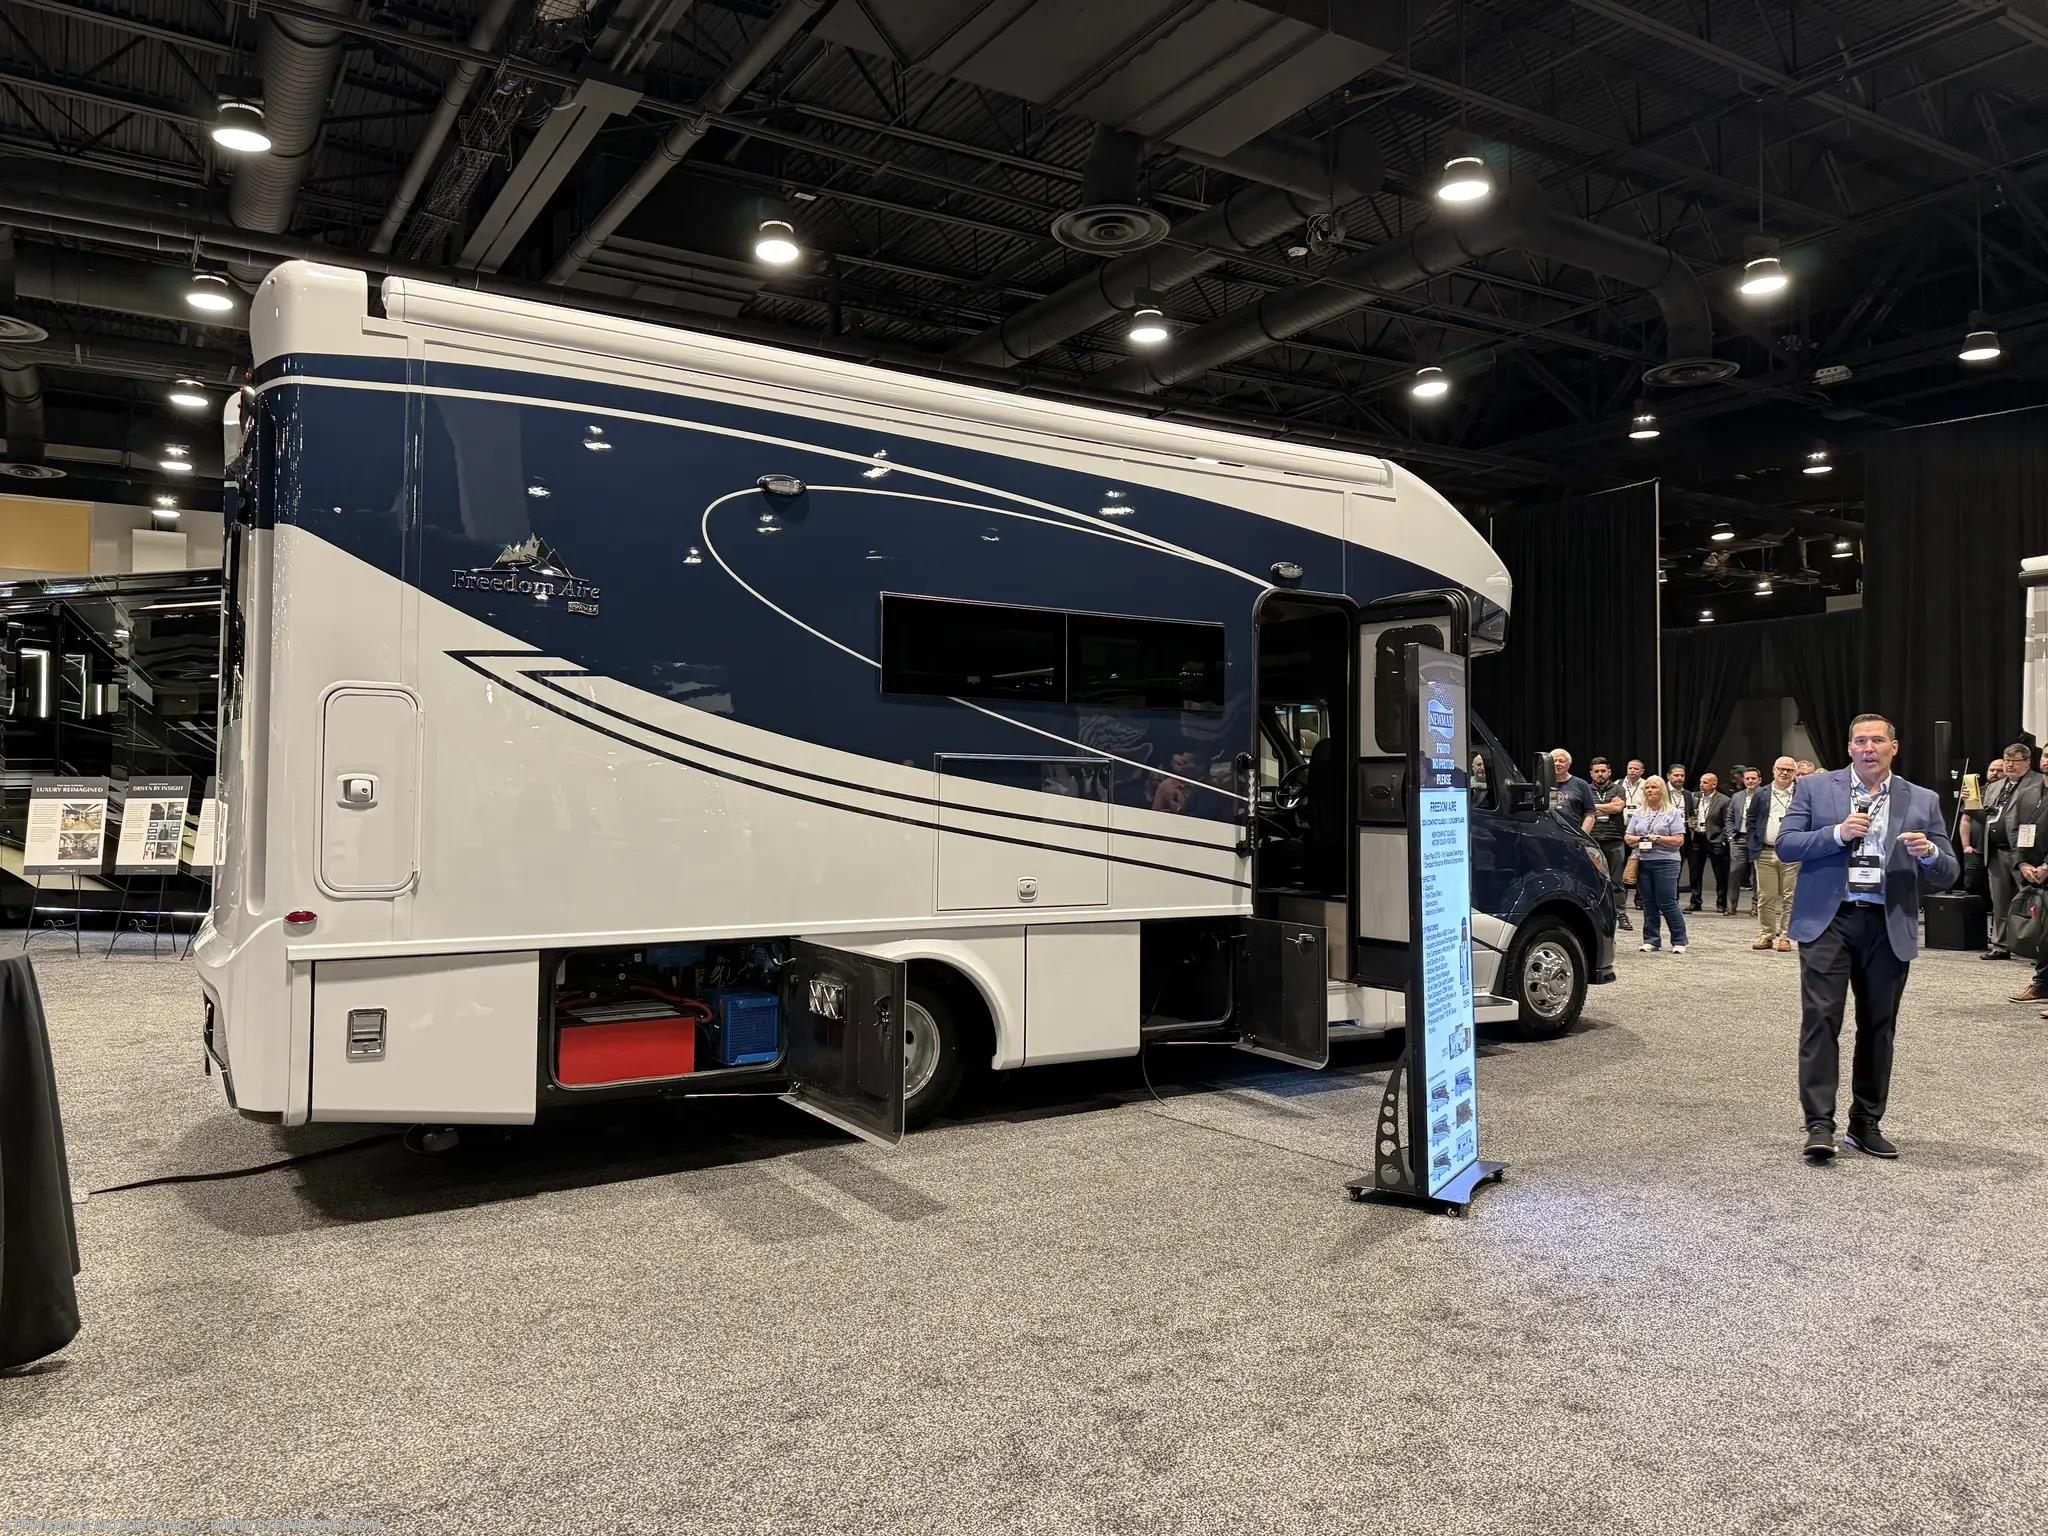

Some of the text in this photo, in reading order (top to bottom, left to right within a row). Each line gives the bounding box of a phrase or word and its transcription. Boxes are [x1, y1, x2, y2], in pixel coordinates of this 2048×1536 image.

[452, 569, 600, 600] Freedom Aire
[1430, 712, 1453, 727] NEWMAR
[1436, 774, 1452, 785] PLEASE
